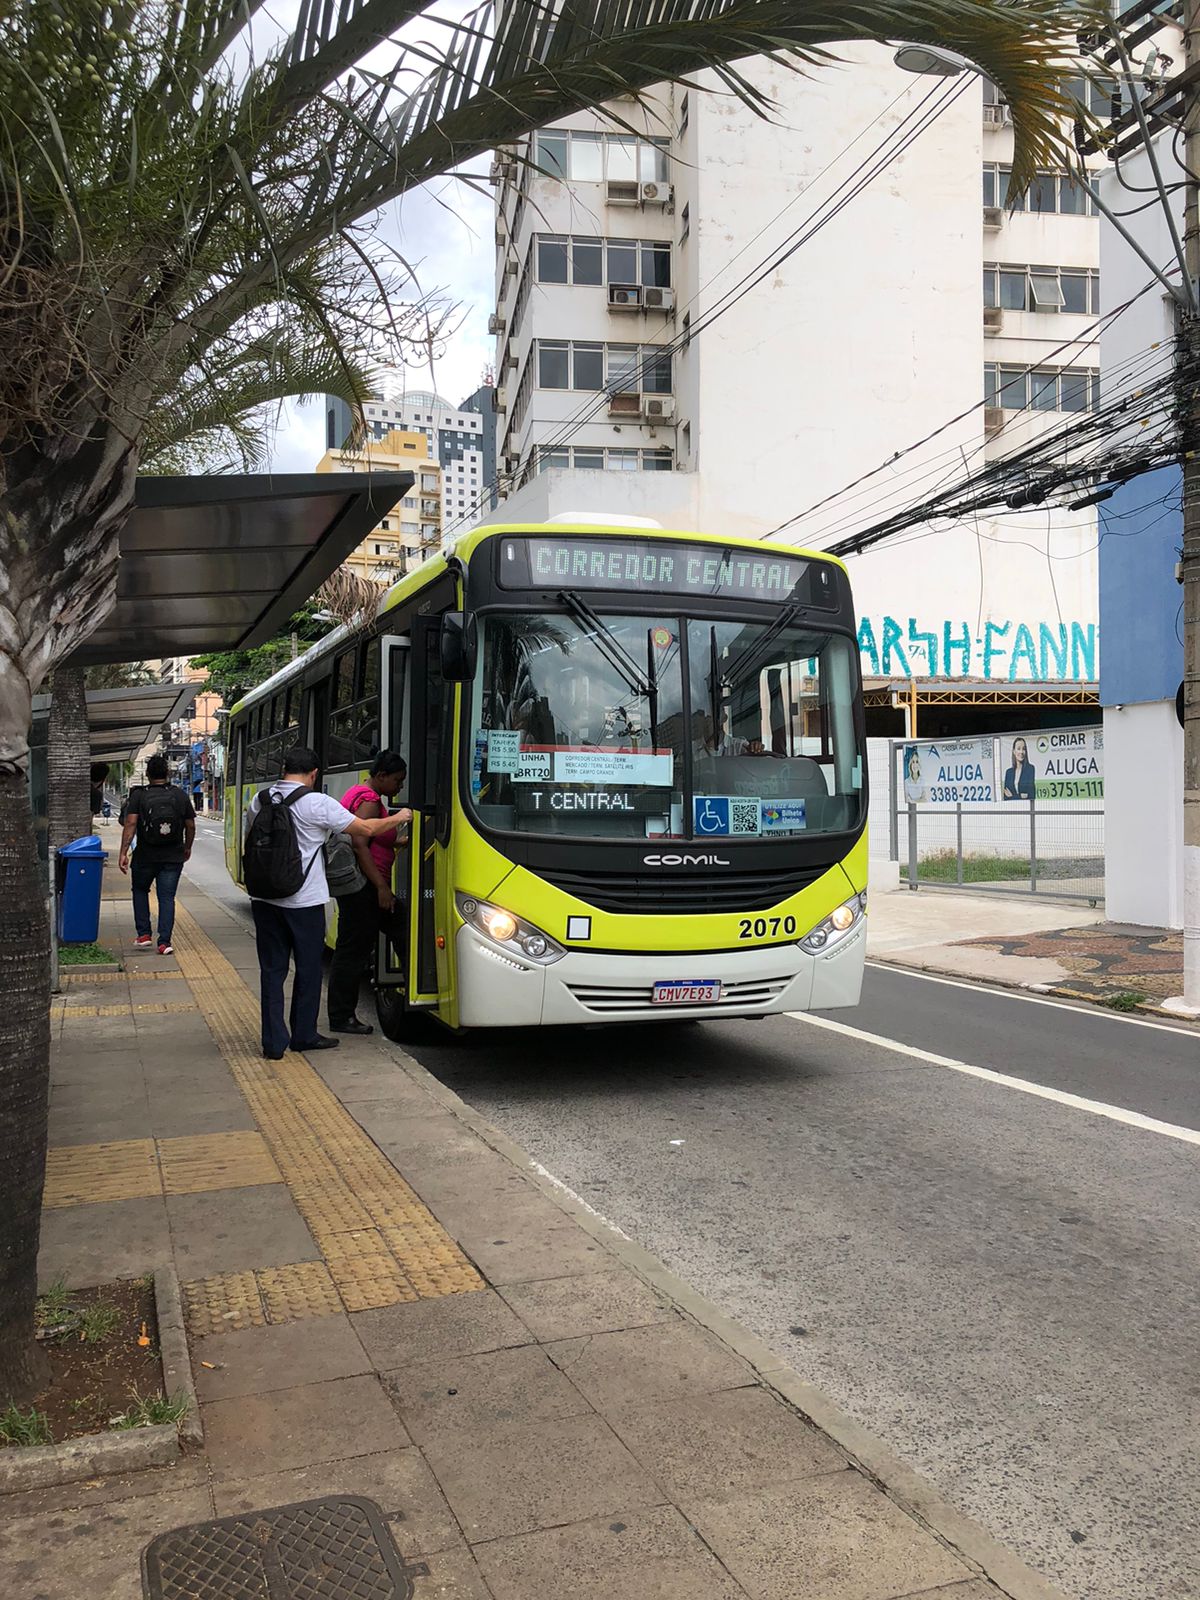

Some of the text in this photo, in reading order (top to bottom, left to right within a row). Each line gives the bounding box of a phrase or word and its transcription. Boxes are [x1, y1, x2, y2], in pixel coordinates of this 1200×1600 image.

[536, 547, 796, 590] CORREDOR CENTRAL
[1050, 733, 1086, 747] CRIAR
[521, 754, 546, 762] LINHA
[1045, 757, 1099, 775] ALUGA
[517, 768, 550, 778] BRT20
[937, 764, 984, 782] ALUGA
[930, 785, 992, 802] 3388-2222
[1037, 786, 1050, 798] (19)
[532, 792, 635, 810] T CENTRAL
[643, 854, 730, 866] COMIL
[739, 915, 797, 940] 2070
[658, 986, 713, 1001] CMV7E93
